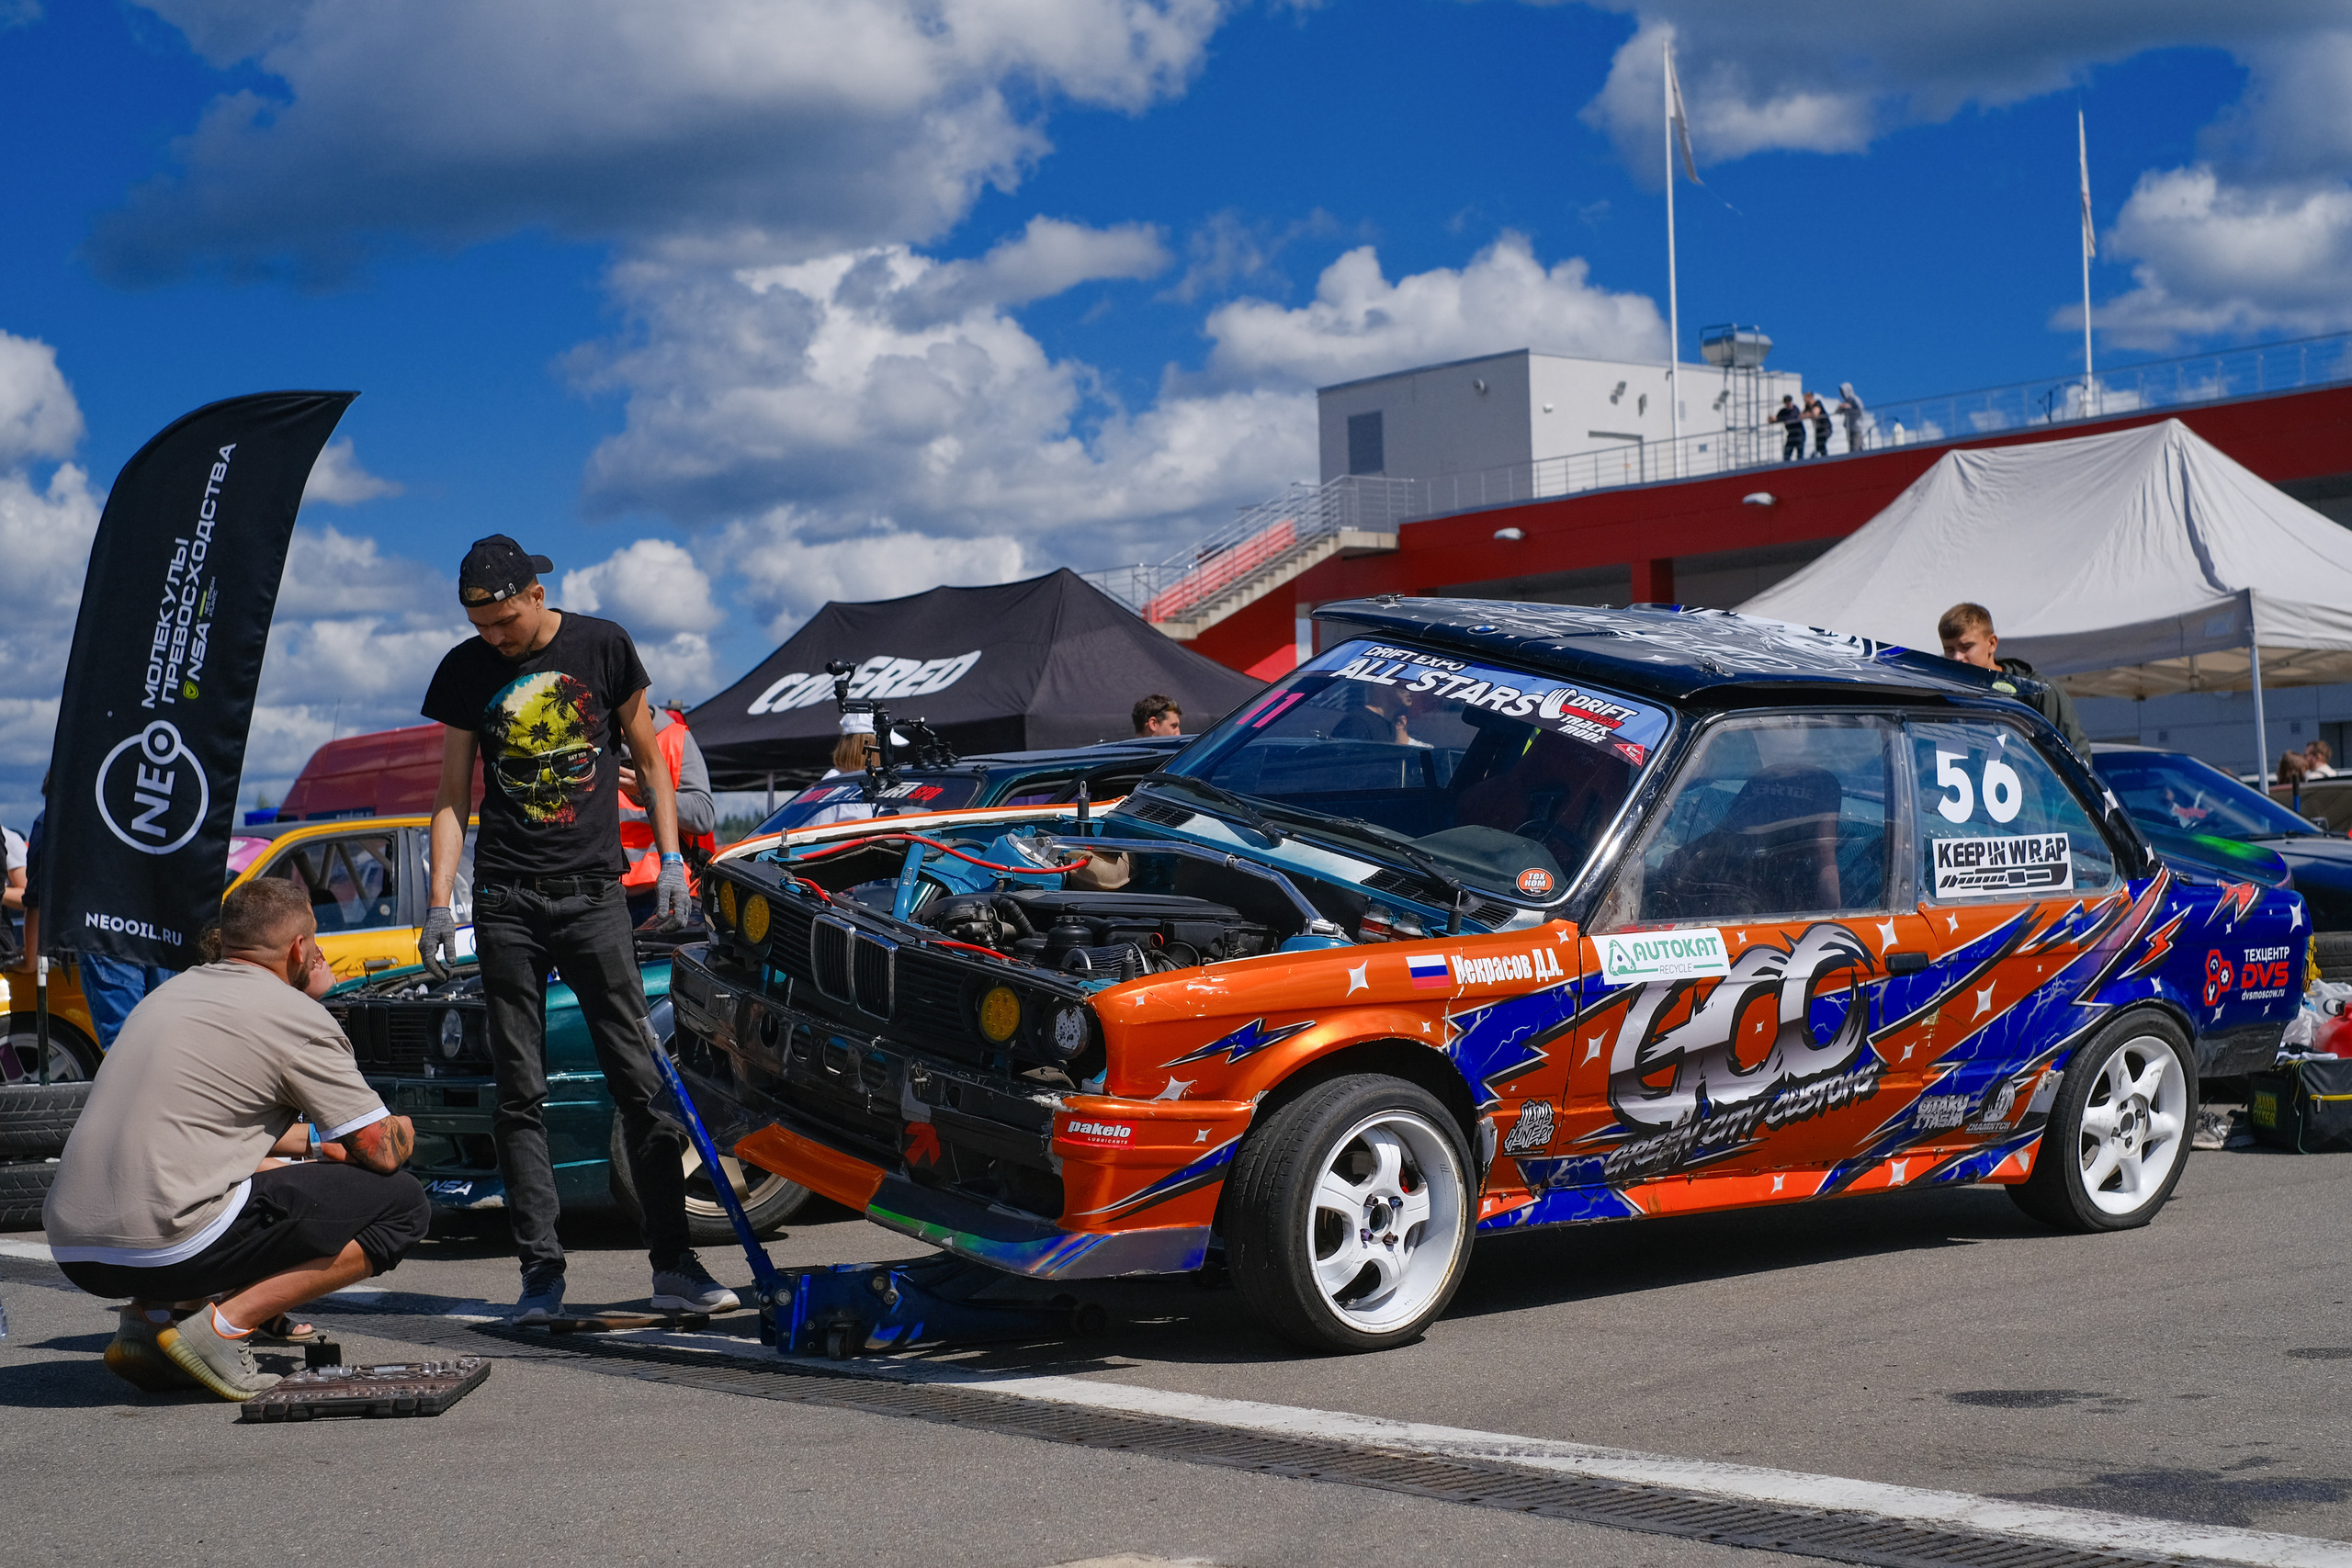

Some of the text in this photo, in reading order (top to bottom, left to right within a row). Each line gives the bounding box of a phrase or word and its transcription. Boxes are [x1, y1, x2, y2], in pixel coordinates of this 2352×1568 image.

[161, 443, 237, 705] ПРЕВОСХОДСТВА
[141, 537, 189, 709] МОЛЕКУЛЫ
[187, 622, 211, 682] NSA
[1363, 646, 1466, 671] DRIFT EXPO
[1329, 657, 1546, 717] ALL STARS
[1566, 694, 1640, 722] DRIFT
[1588, 713, 1616, 726] EXPO
[1556, 724, 1608, 744] MODE
[1559, 715, 1613, 736] TRACK
[130, 719, 183, 839] NEO
[1935, 733, 2023, 824] 56
[1938, 837, 2067, 869] KEEP IN WRAP
[85, 911, 183, 947] NEOOIL.RU
[1633, 936, 1718, 962] AUTOKAT
[2244, 945, 2290, 963] ТЕХЦЕНТР
[1450, 947, 1565, 985] Некрасов Д.А.
[1659, 962, 1693, 975] RECYCLE
[2240, 962, 2290, 989] DVS
[2241, 988, 2286, 1000] dvsmoscow.ru
[1701, 1103, 1767, 1145] CITY
[1763, 1061, 1881, 1124] CUSTOMS
[1067, 1120, 1132, 1138] pakelo
[1087, 1136, 1128, 1145] LUBRICANTS
[423, 1179, 474, 1196] NSA
